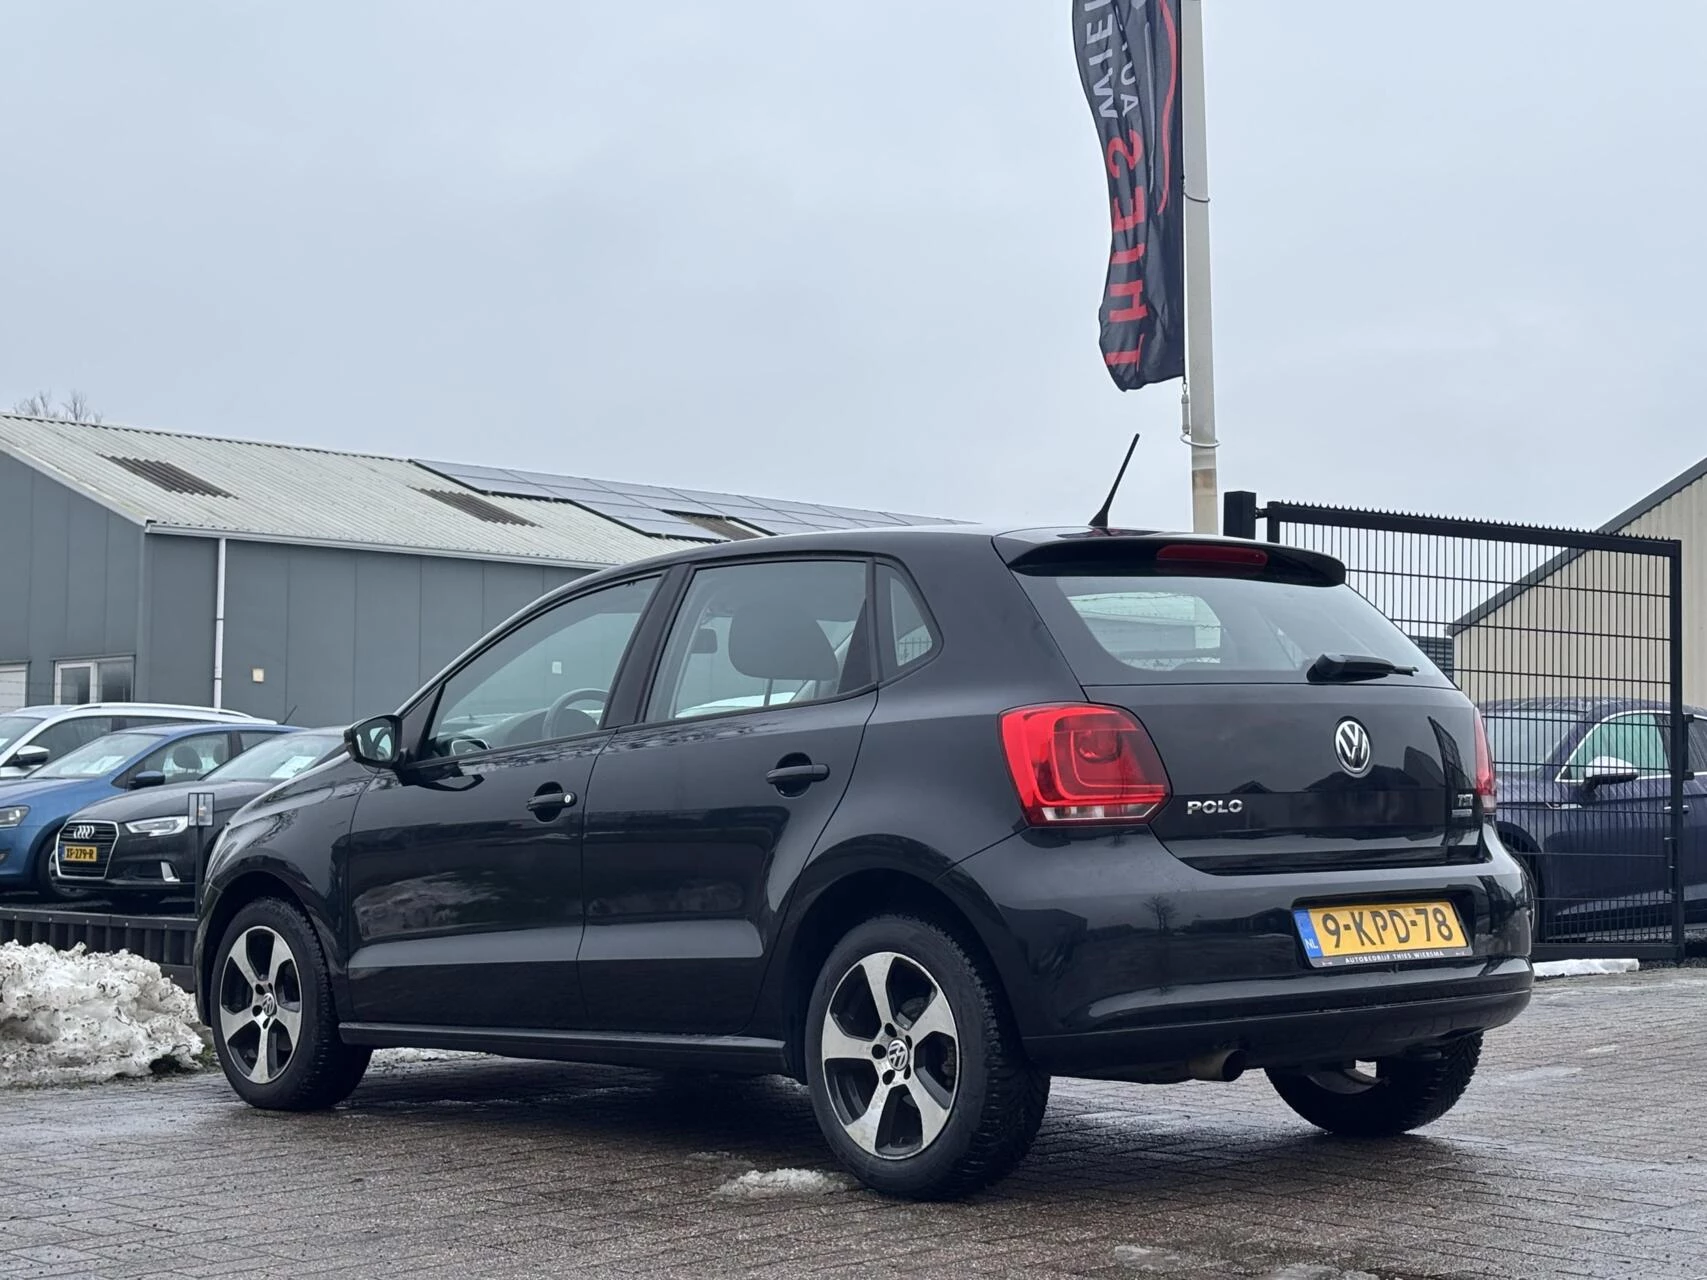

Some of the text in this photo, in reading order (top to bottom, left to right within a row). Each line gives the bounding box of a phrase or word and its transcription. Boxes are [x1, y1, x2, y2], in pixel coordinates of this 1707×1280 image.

[1187, 799, 1243, 815] POLO
[1321, 907, 1453, 949] 9-KPD-78
[1304, 937, 1319, 950] NL
[1345, 953, 1390, 964] AUTOBEDRIJF
[1413, 950, 1445, 959] WIERSMA
